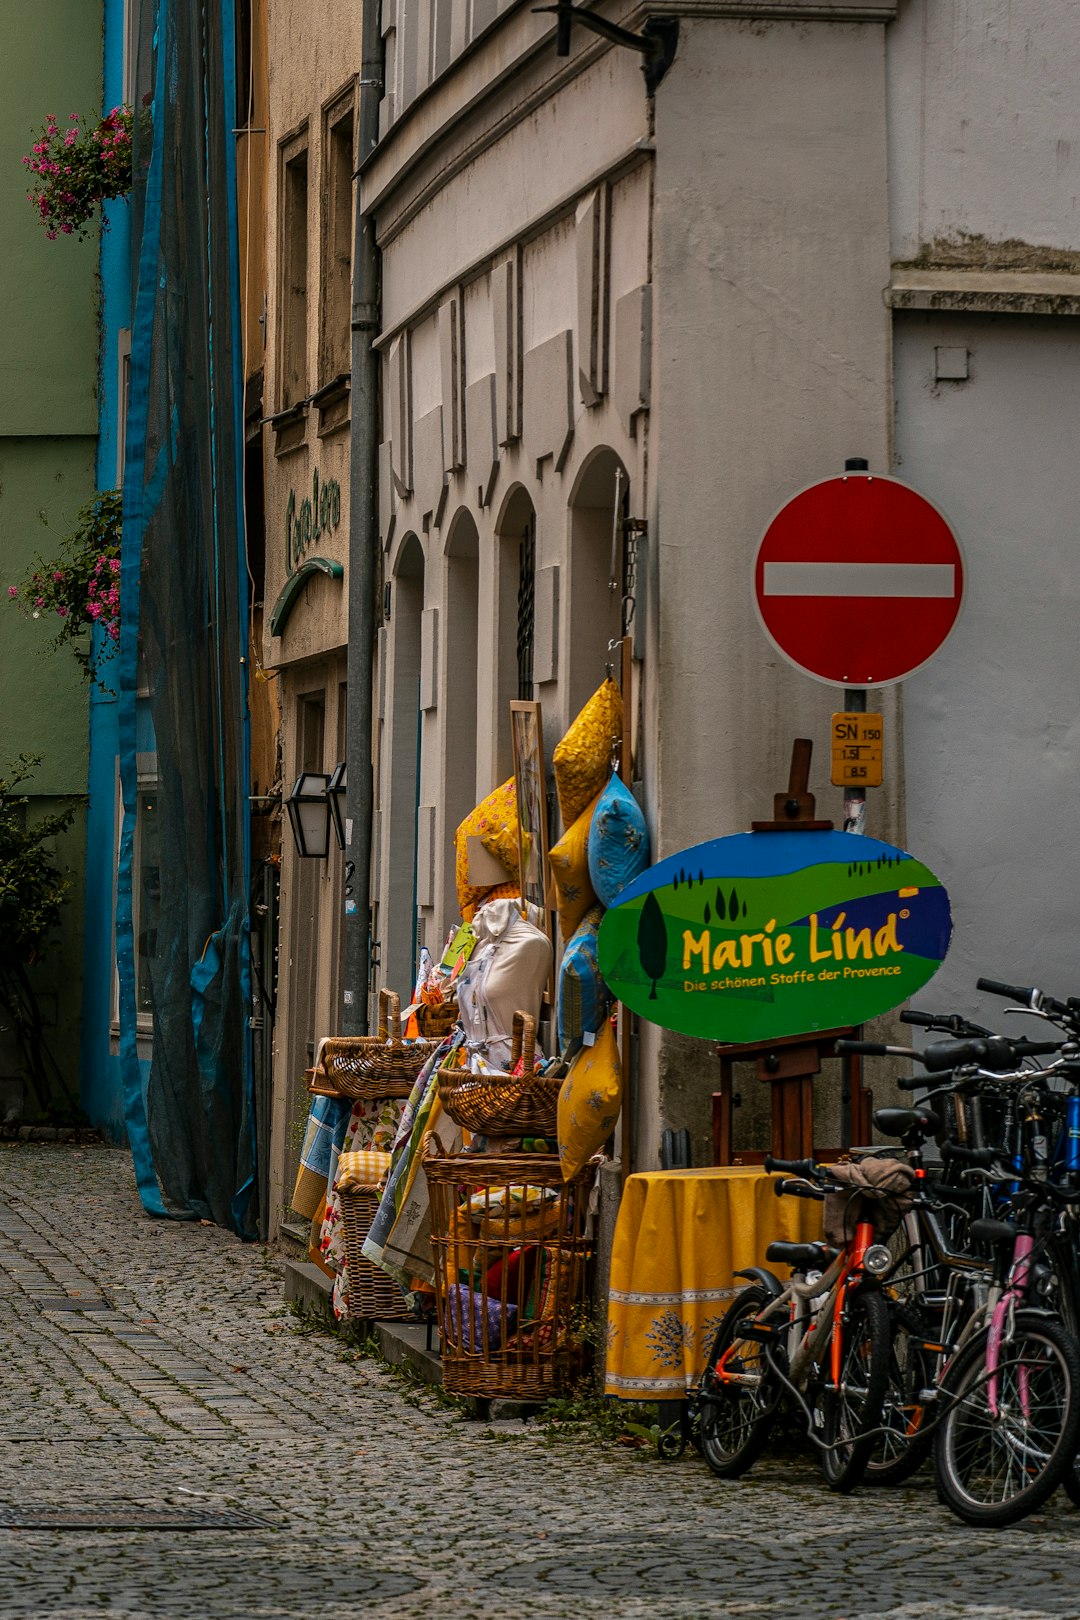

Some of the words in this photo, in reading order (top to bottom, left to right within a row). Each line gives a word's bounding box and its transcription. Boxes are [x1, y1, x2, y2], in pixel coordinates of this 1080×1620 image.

[835, 724, 858, 739] SN
[863, 729, 881, 740] 150
[851, 767, 868, 777] 8.5
[683, 979, 708, 993] Die
[710, 975, 766, 991] schönen
[770, 970, 815, 986] Stoffe
[817, 966, 841, 981] der
[843, 964, 902, 980] Provence
